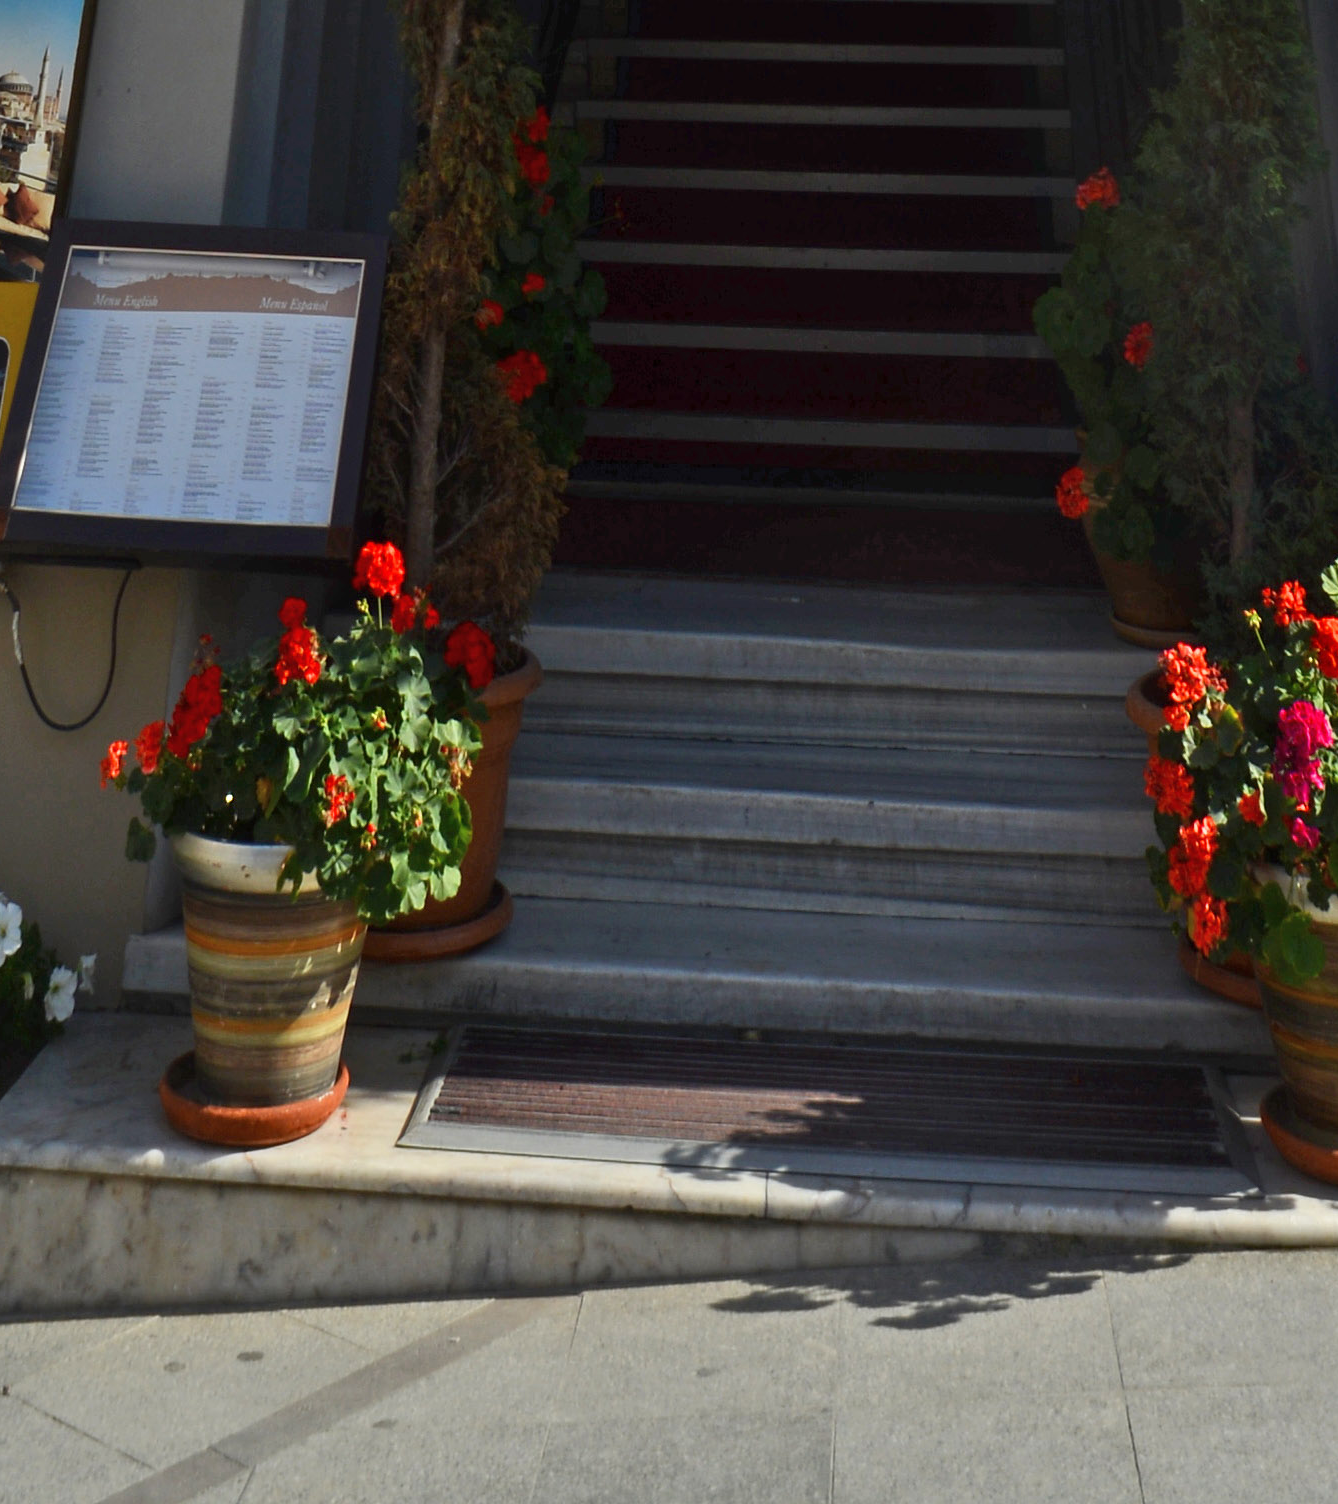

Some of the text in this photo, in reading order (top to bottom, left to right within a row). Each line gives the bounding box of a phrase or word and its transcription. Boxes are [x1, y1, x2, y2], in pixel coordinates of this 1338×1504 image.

[93, 294, 159, 308] Menu English
[259, 297, 288, 310] Menu
